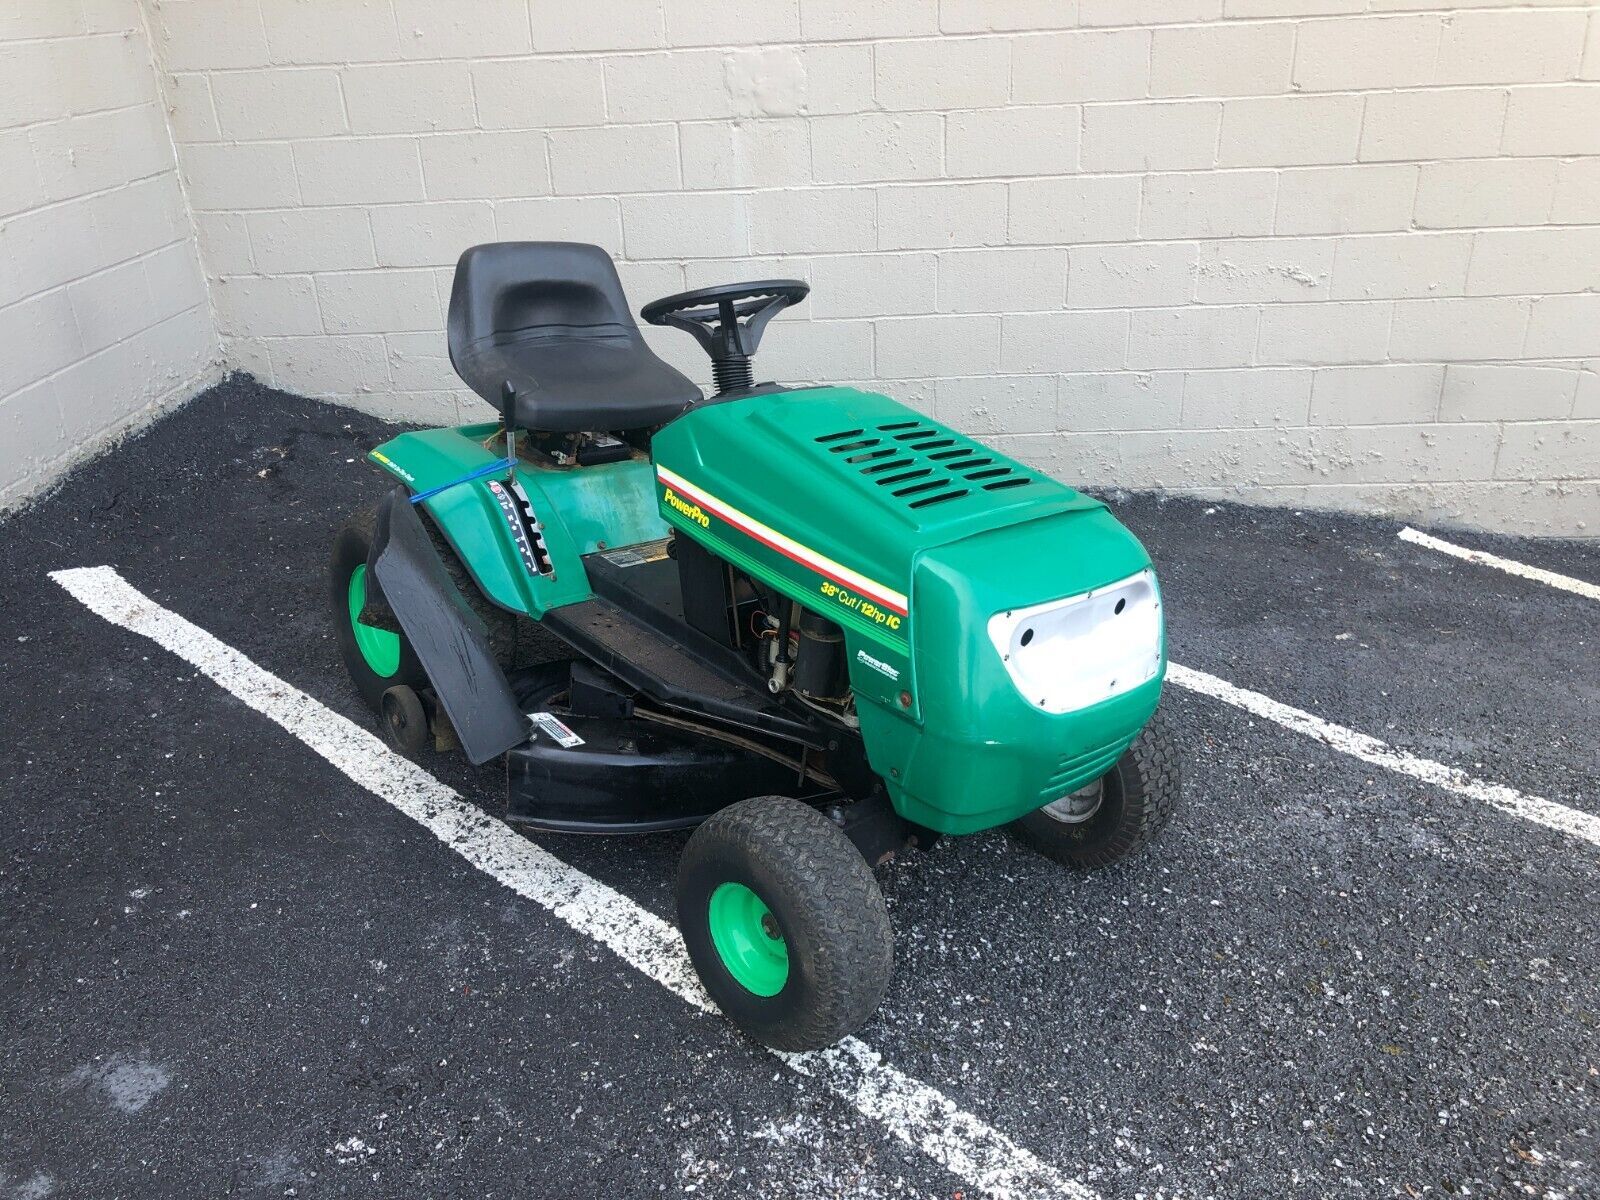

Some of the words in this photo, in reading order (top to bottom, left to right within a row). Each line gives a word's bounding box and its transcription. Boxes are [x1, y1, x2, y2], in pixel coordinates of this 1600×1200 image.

[664, 488, 710, 528] PowerPro
[820, 581, 839, 597] 38"
[838, 591, 856, 608] Cut
[860, 602, 886, 623] 12hp
[885, 614, 901, 630] IC
